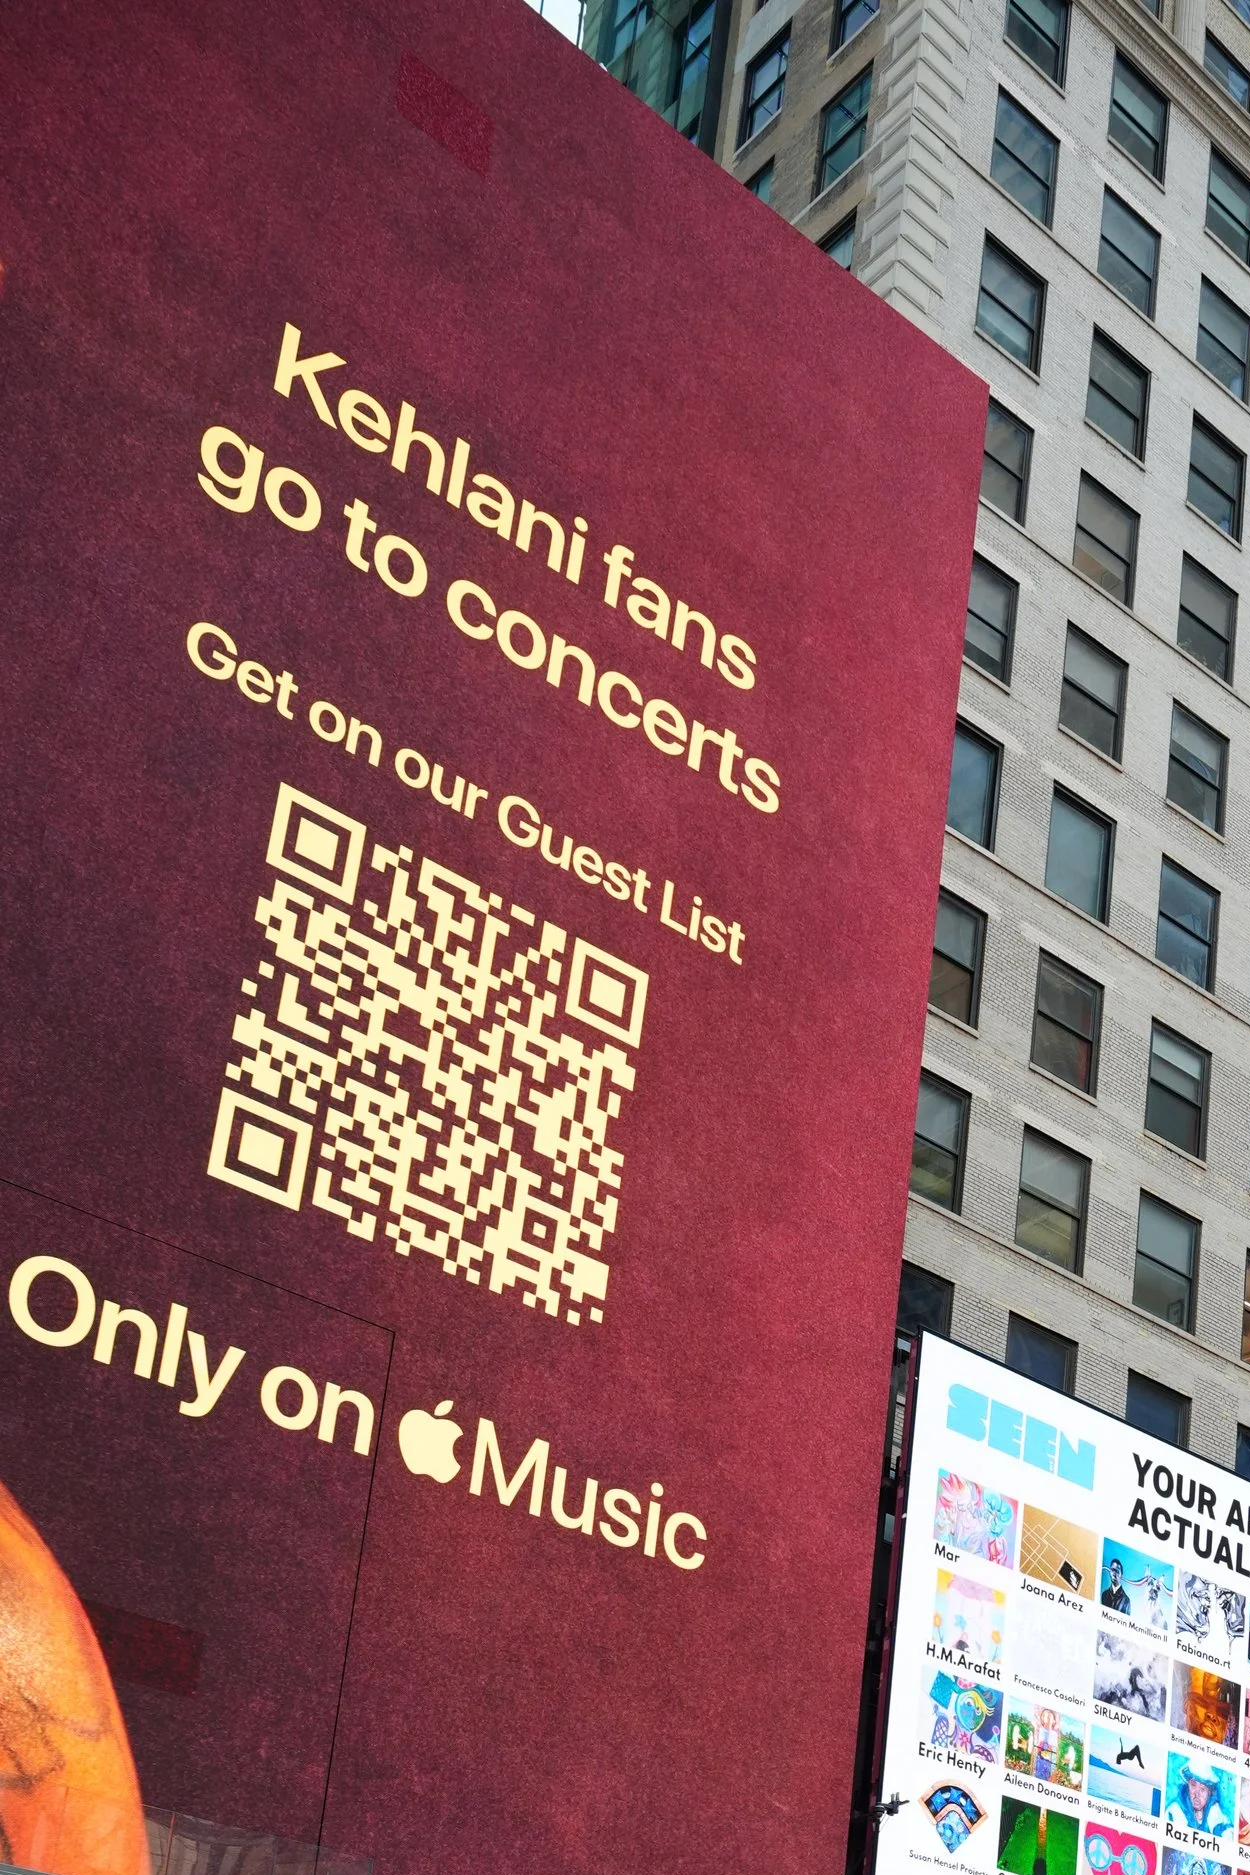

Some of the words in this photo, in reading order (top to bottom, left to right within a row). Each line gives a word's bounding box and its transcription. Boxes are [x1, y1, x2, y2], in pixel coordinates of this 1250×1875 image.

[273, 321, 590, 585] Kehlani
[603, 545, 759, 692] fans
[197, 424, 323, 533] go
[343, 503, 428, 598] to
[446, 578, 782, 815] concerts
[186, 621, 296, 720] Get
[308, 700, 382, 768] on
[394, 746, 488, 820] our
[496, 794, 651, 916] Guest
[659, 879, 746, 966] List
[8, 1255, 246, 1419] Only
[260, 1364, 375, 1457] on
[468, 1416, 708, 1571] Music
[946, 1383, 1097, 1492] SEEN
[1132, 1452, 1217, 1521] YOUR
[934, 1543, 960, 1564] Mar
[1020, 1582, 1055, 1604] Joana
[1058, 1592, 1084, 1613] Arez
[926, 1642, 1001, 1681] H.M.Arafat
[1176, 1639, 1231, 1670] Fabianaa.rt
[1093, 1704, 1133, 1726] SIRLADY
[918, 1742, 943, 1762] Eric
[947, 1752, 986, 1779] Henty
[1004, 1772, 1035, 1792] Aileen
[1037, 1784, 1080, 1805] Donovan
[1165, 1823, 1188, 1843] Raz
[1192, 1834, 1220, 1853] Forh
